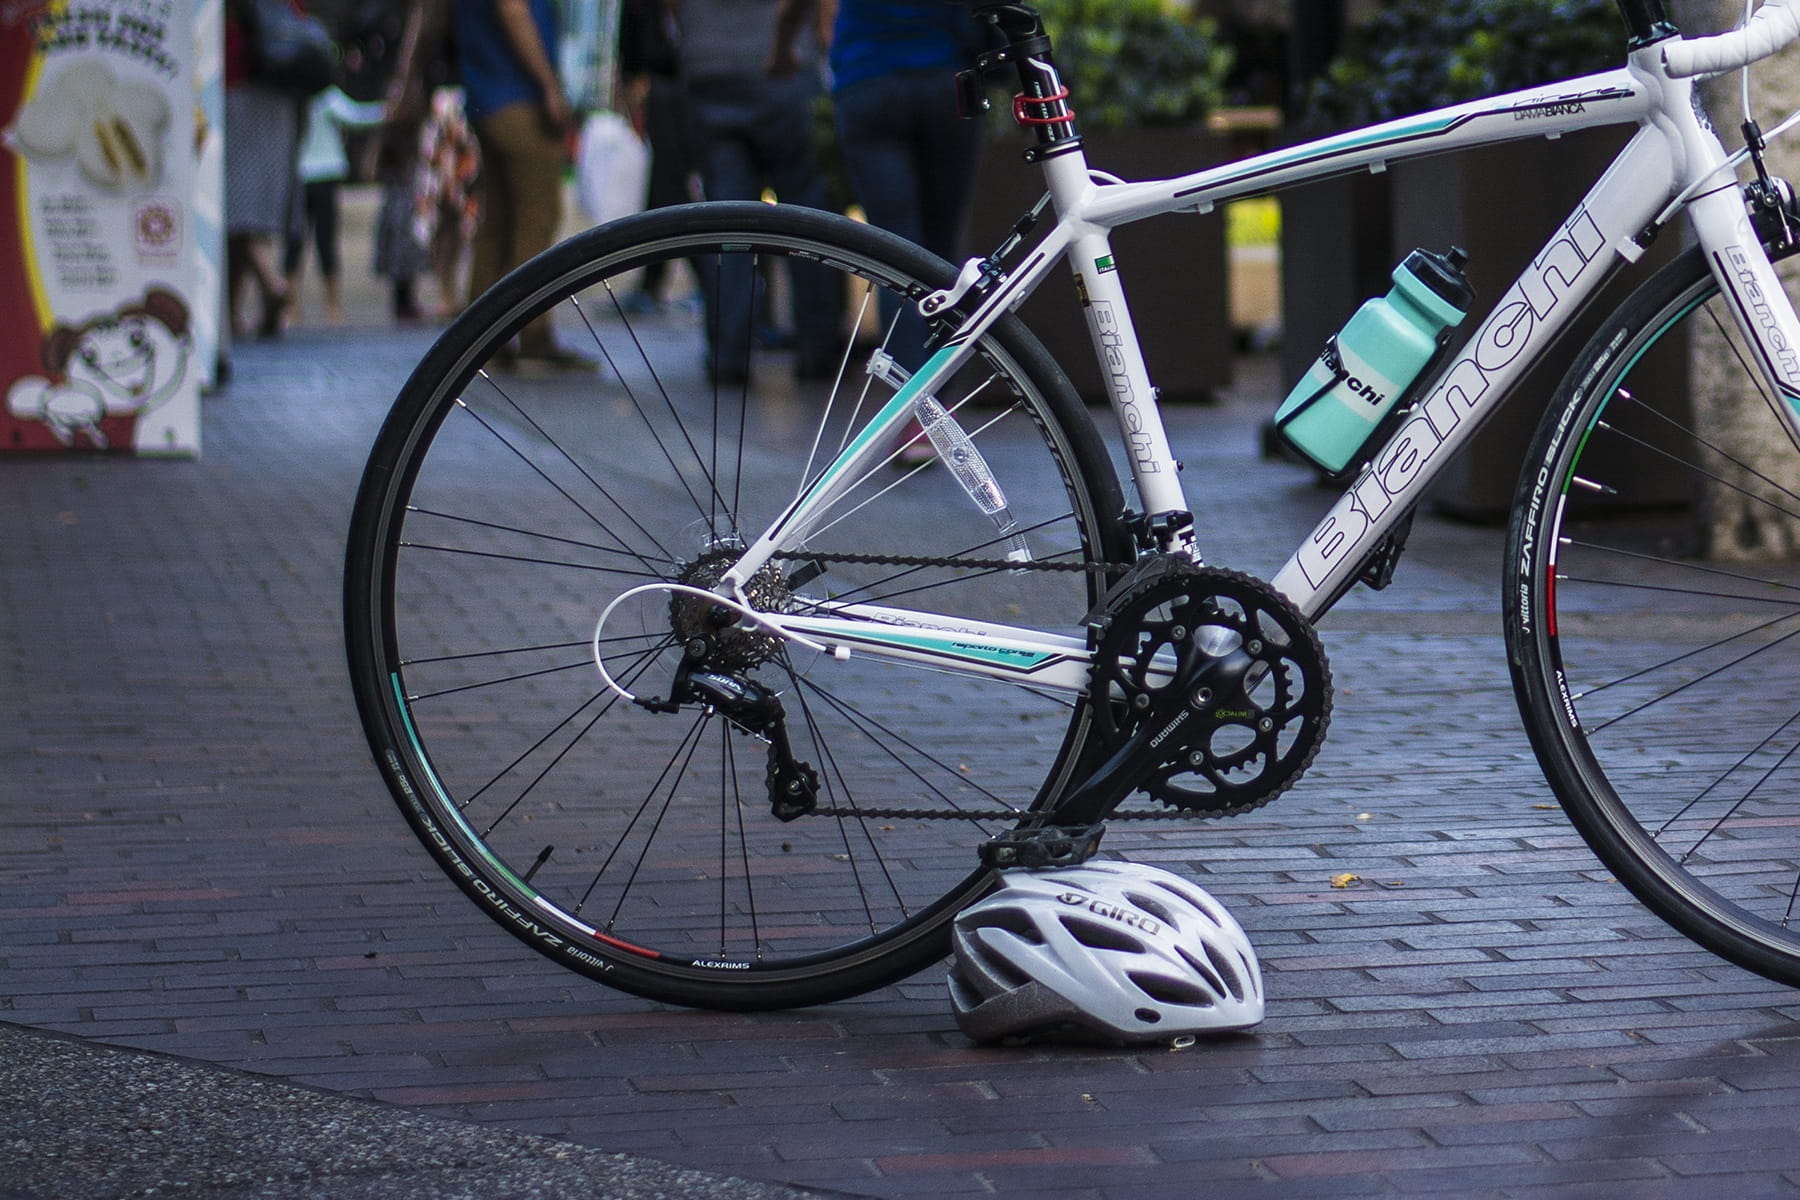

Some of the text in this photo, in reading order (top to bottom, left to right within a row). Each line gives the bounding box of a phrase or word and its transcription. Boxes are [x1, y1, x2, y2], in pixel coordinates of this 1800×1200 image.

[1514, 103, 1586, 121] DAMABIANCA
[1091, 300, 1161, 474] Bianchi
[1297, 204, 1606, 590] Bianchi
[1546, 391, 1582, 462] SLICK
[1521, 467, 1548, 577] ZAFFIRO
[1519, 583, 1530, 624] vittoria
[951, 641, 998, 653] reparto
[1555, 670, 1578, 728] ALEXRIMS
[1149, 709, 1190, 749] SHIMANO
[421, 816, 478, 878] SLICK
[473, 878, 563, 947] ZAFFIRO
[1088, 899, 1161, 936] GIRO
[566, 946, 604, 969] vittoria
[691, 959, 751, 970] ALEXRIMS
